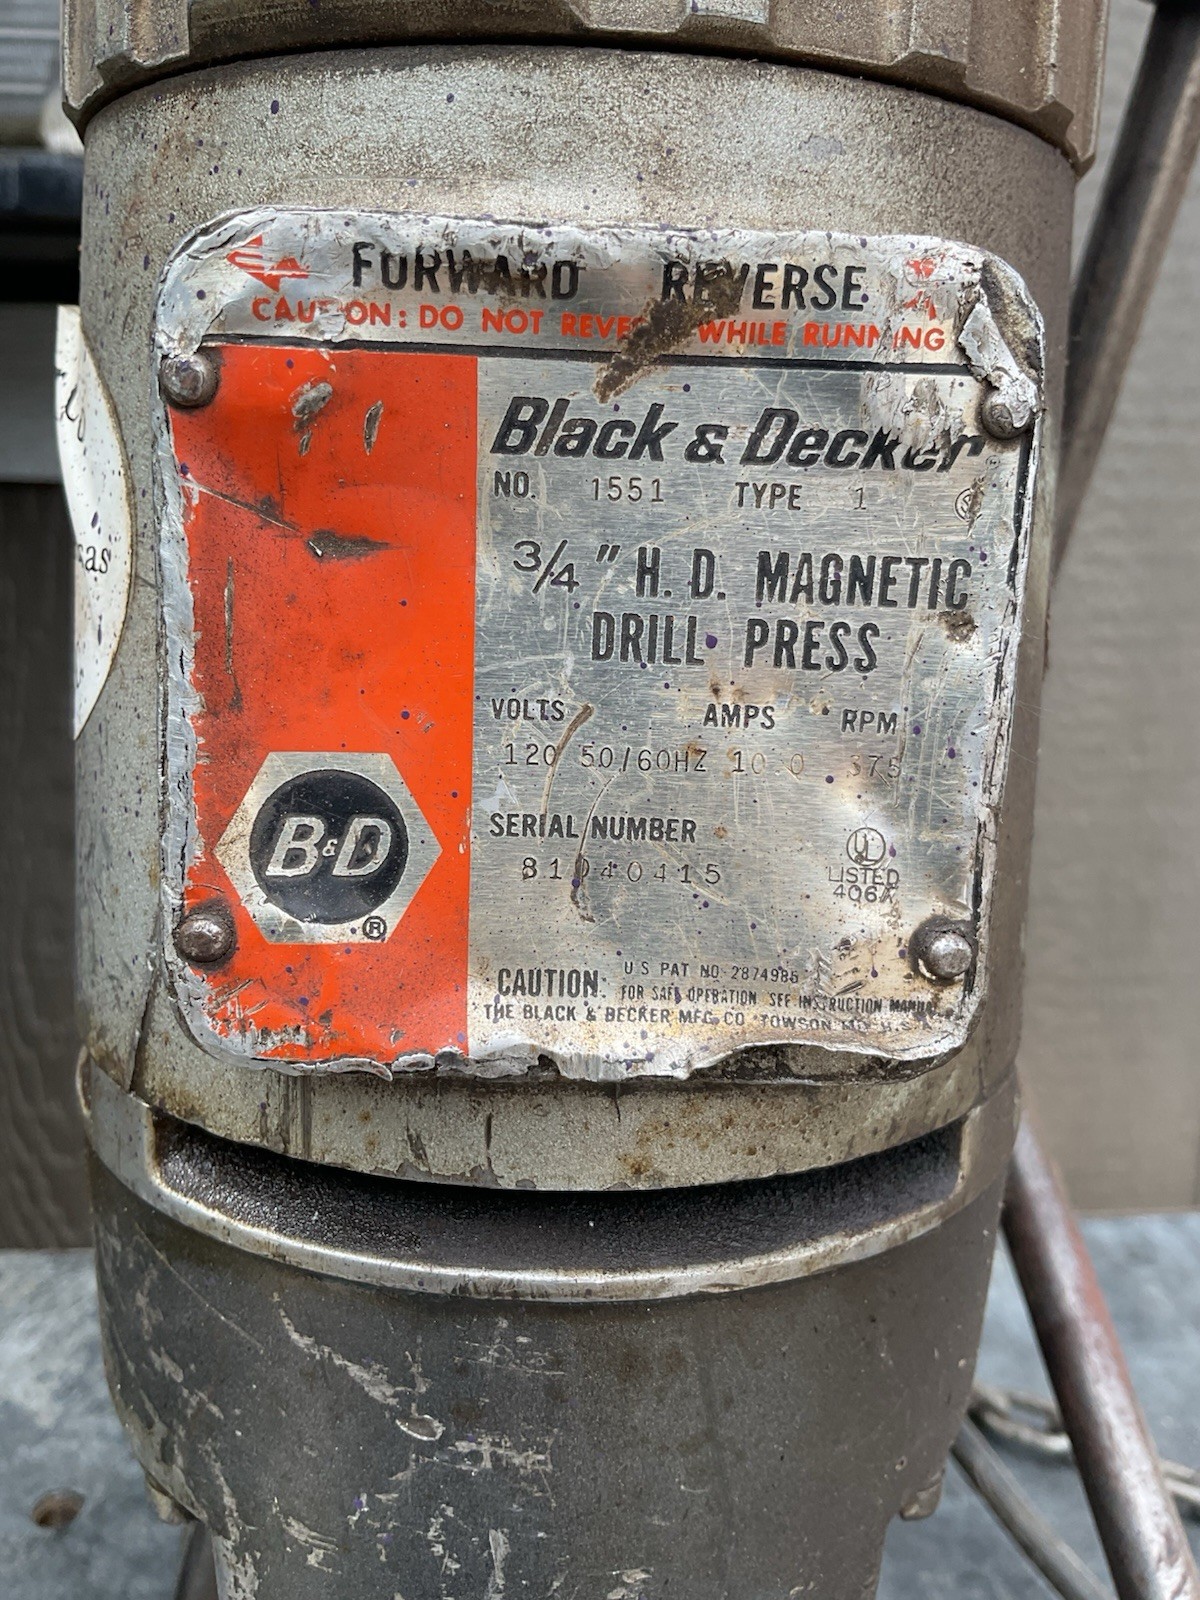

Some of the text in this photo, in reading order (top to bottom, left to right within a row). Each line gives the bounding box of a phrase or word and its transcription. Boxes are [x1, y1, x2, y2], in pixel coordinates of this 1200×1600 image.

[252, 296, 407, 329] CAUON:
[419, 304, 464, 332] DO
[481, 309, 543, 335] NOT
[698, 319, 786, 346] WHILE
[490, 396, 679, 462] Black
[684, 423, 730, 464] &
[494, 470, 867, 510] NO. 1551 TYPE 1
[755, 550, 971, 611] MAGNETIC
[591, 611, 880, 674] DRILL PRESS
[491, 698, 898, 735] VOLTS AMPS RPM
[505, 743, 557, 767] 120
[580, 745, 708, 773] 50/60HZ
[490, 812, 698, 843] SERIAL NUMBER
[484, 1003, 515, 1023] THE
[522, 1005, 577, 1022] BLACK
